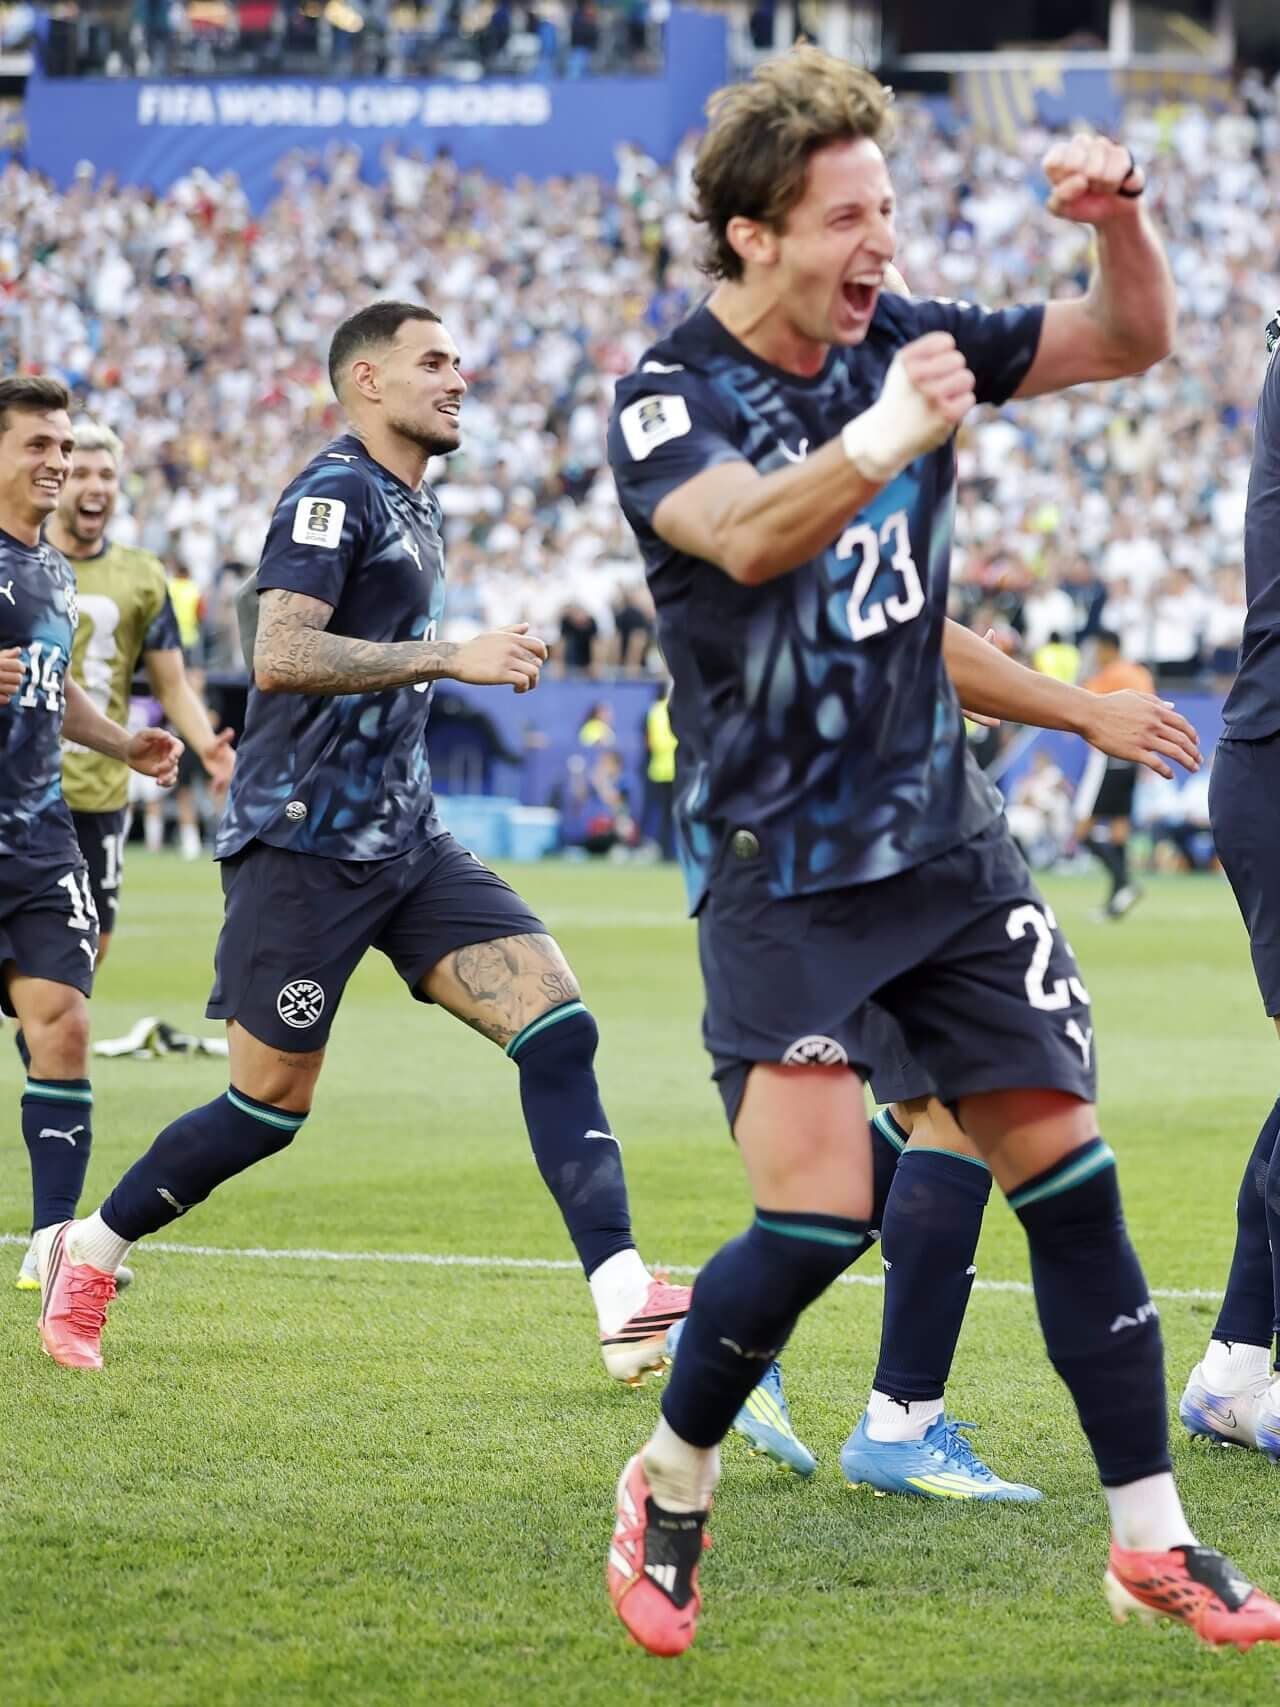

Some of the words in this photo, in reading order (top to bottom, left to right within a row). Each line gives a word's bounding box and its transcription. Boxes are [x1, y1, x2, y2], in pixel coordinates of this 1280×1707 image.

[138, 86, 215, 126] FIFA
[217, 86, 343, 126] WORLD
[348, 86, 421, 126] CUP
[423, 85, 550, 126] 2026
[836, 510, 926, 642] 23
[19, 641, 60, 712] 14
